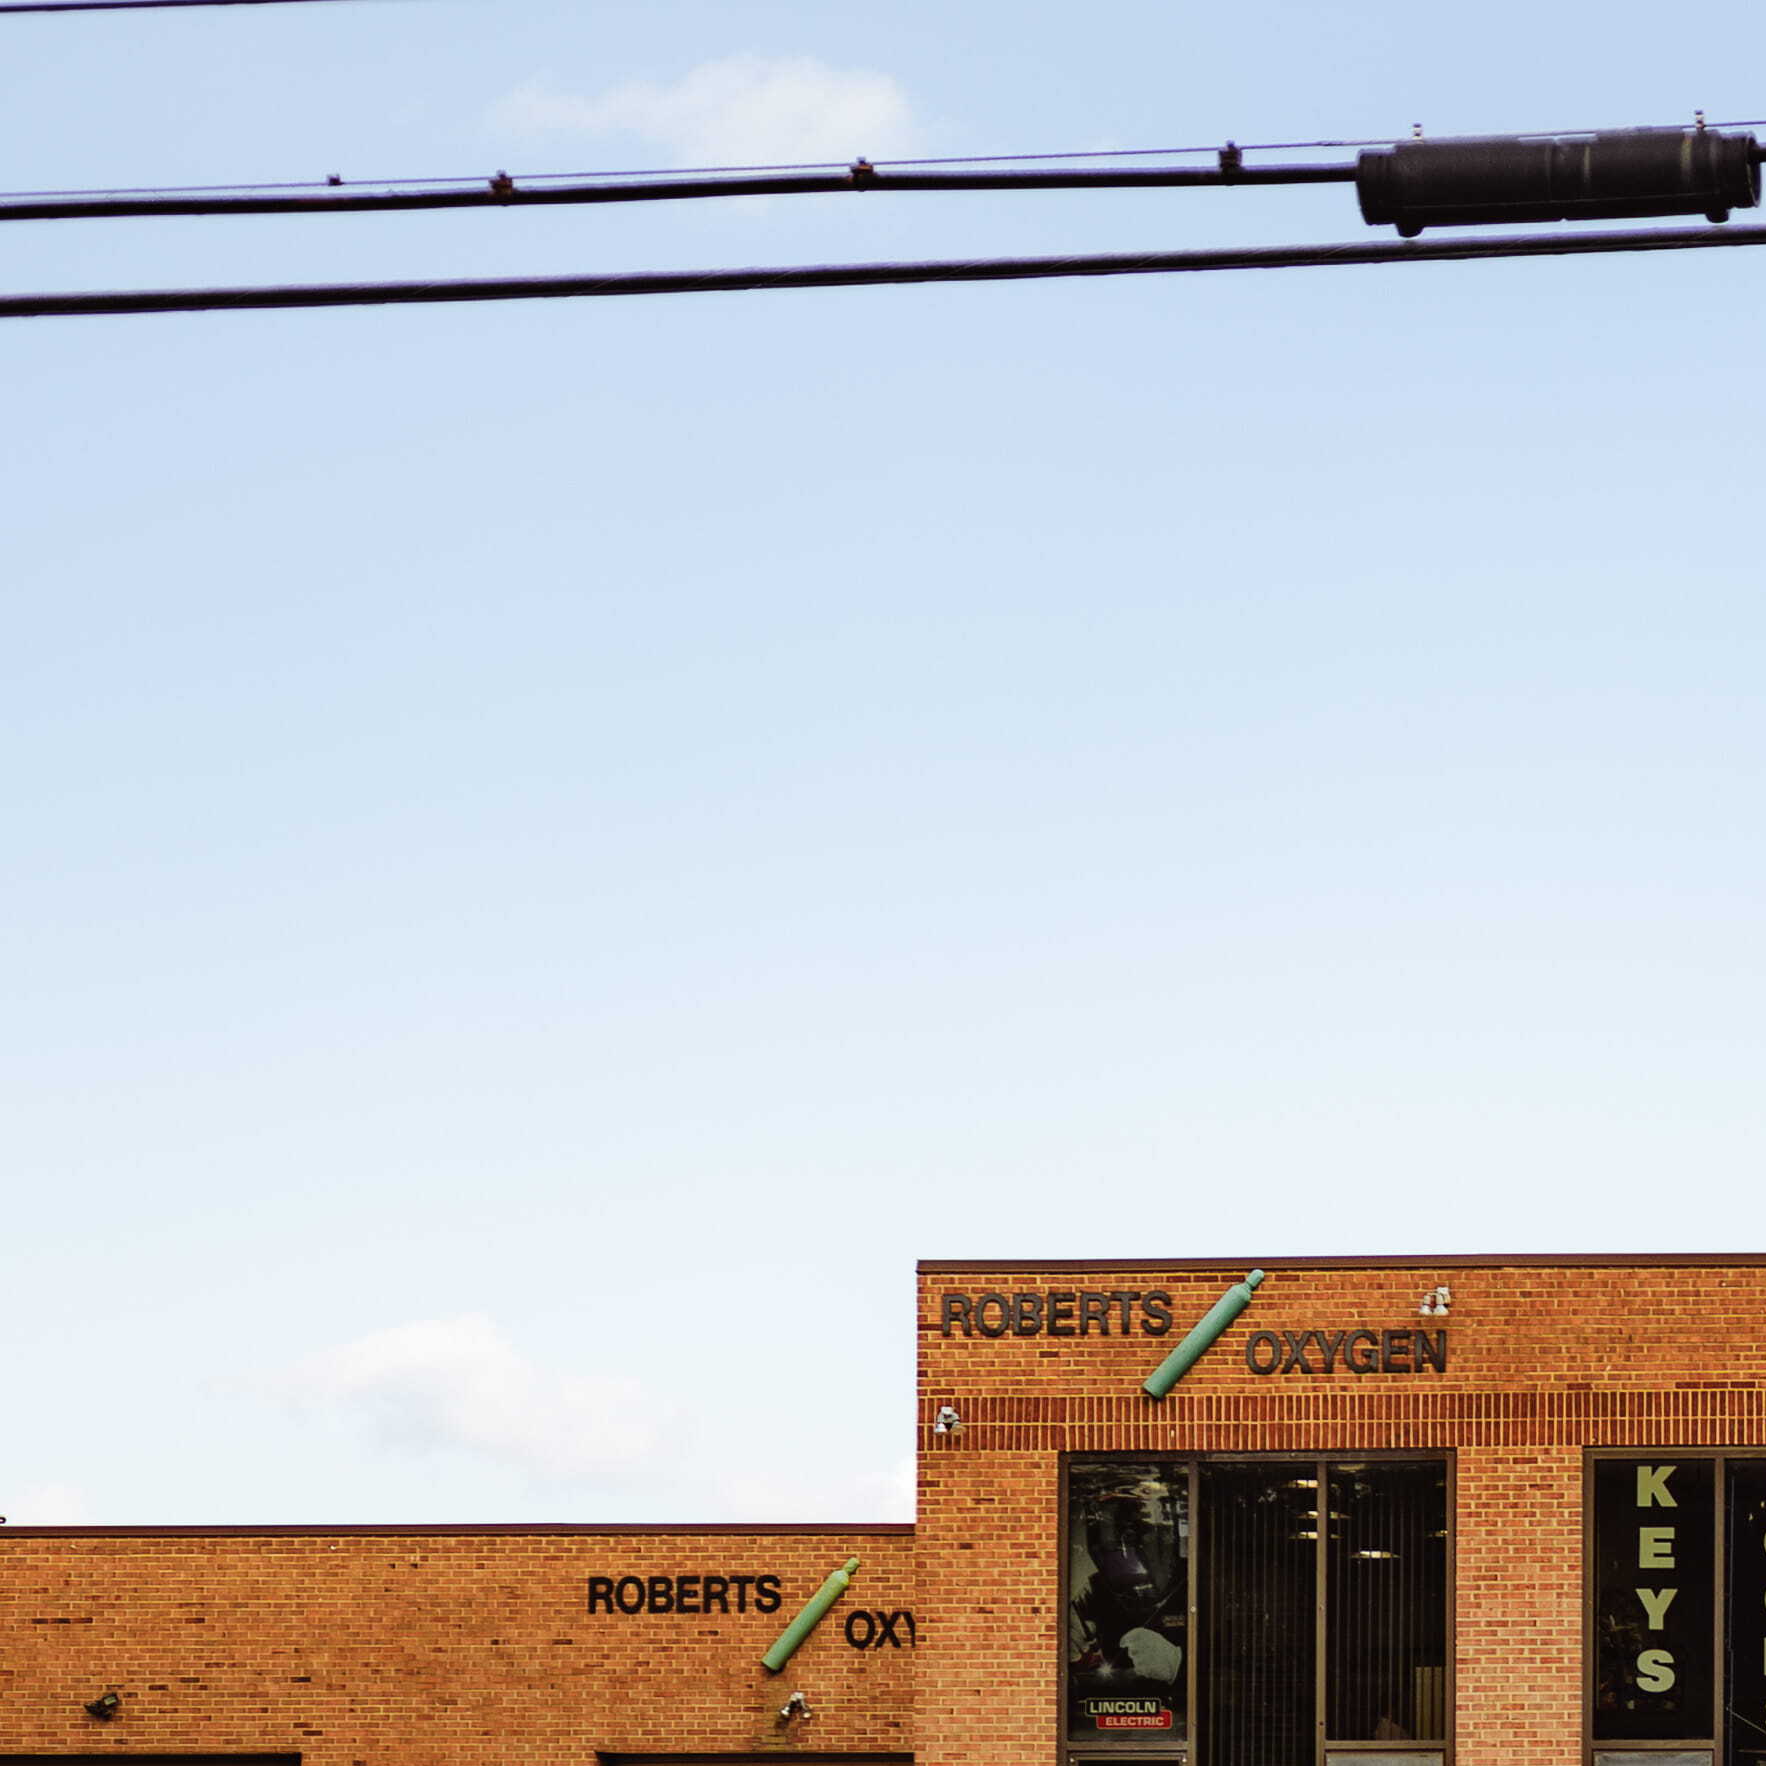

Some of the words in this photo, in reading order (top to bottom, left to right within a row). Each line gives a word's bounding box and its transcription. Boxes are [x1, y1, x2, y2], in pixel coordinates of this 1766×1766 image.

[940, 1289, 1173, 1337] ROBERTS
[1245, 1329, 1447, 1375] OXYGEN
[587, 1574, 782, 1615] ROBERTS
[1635, 1465, 1678, 1692] KEYS
[1089, 1701, 1157, 1713] LINCOLN
[1105, 1717, 1165, 1726] ELECTRIC
